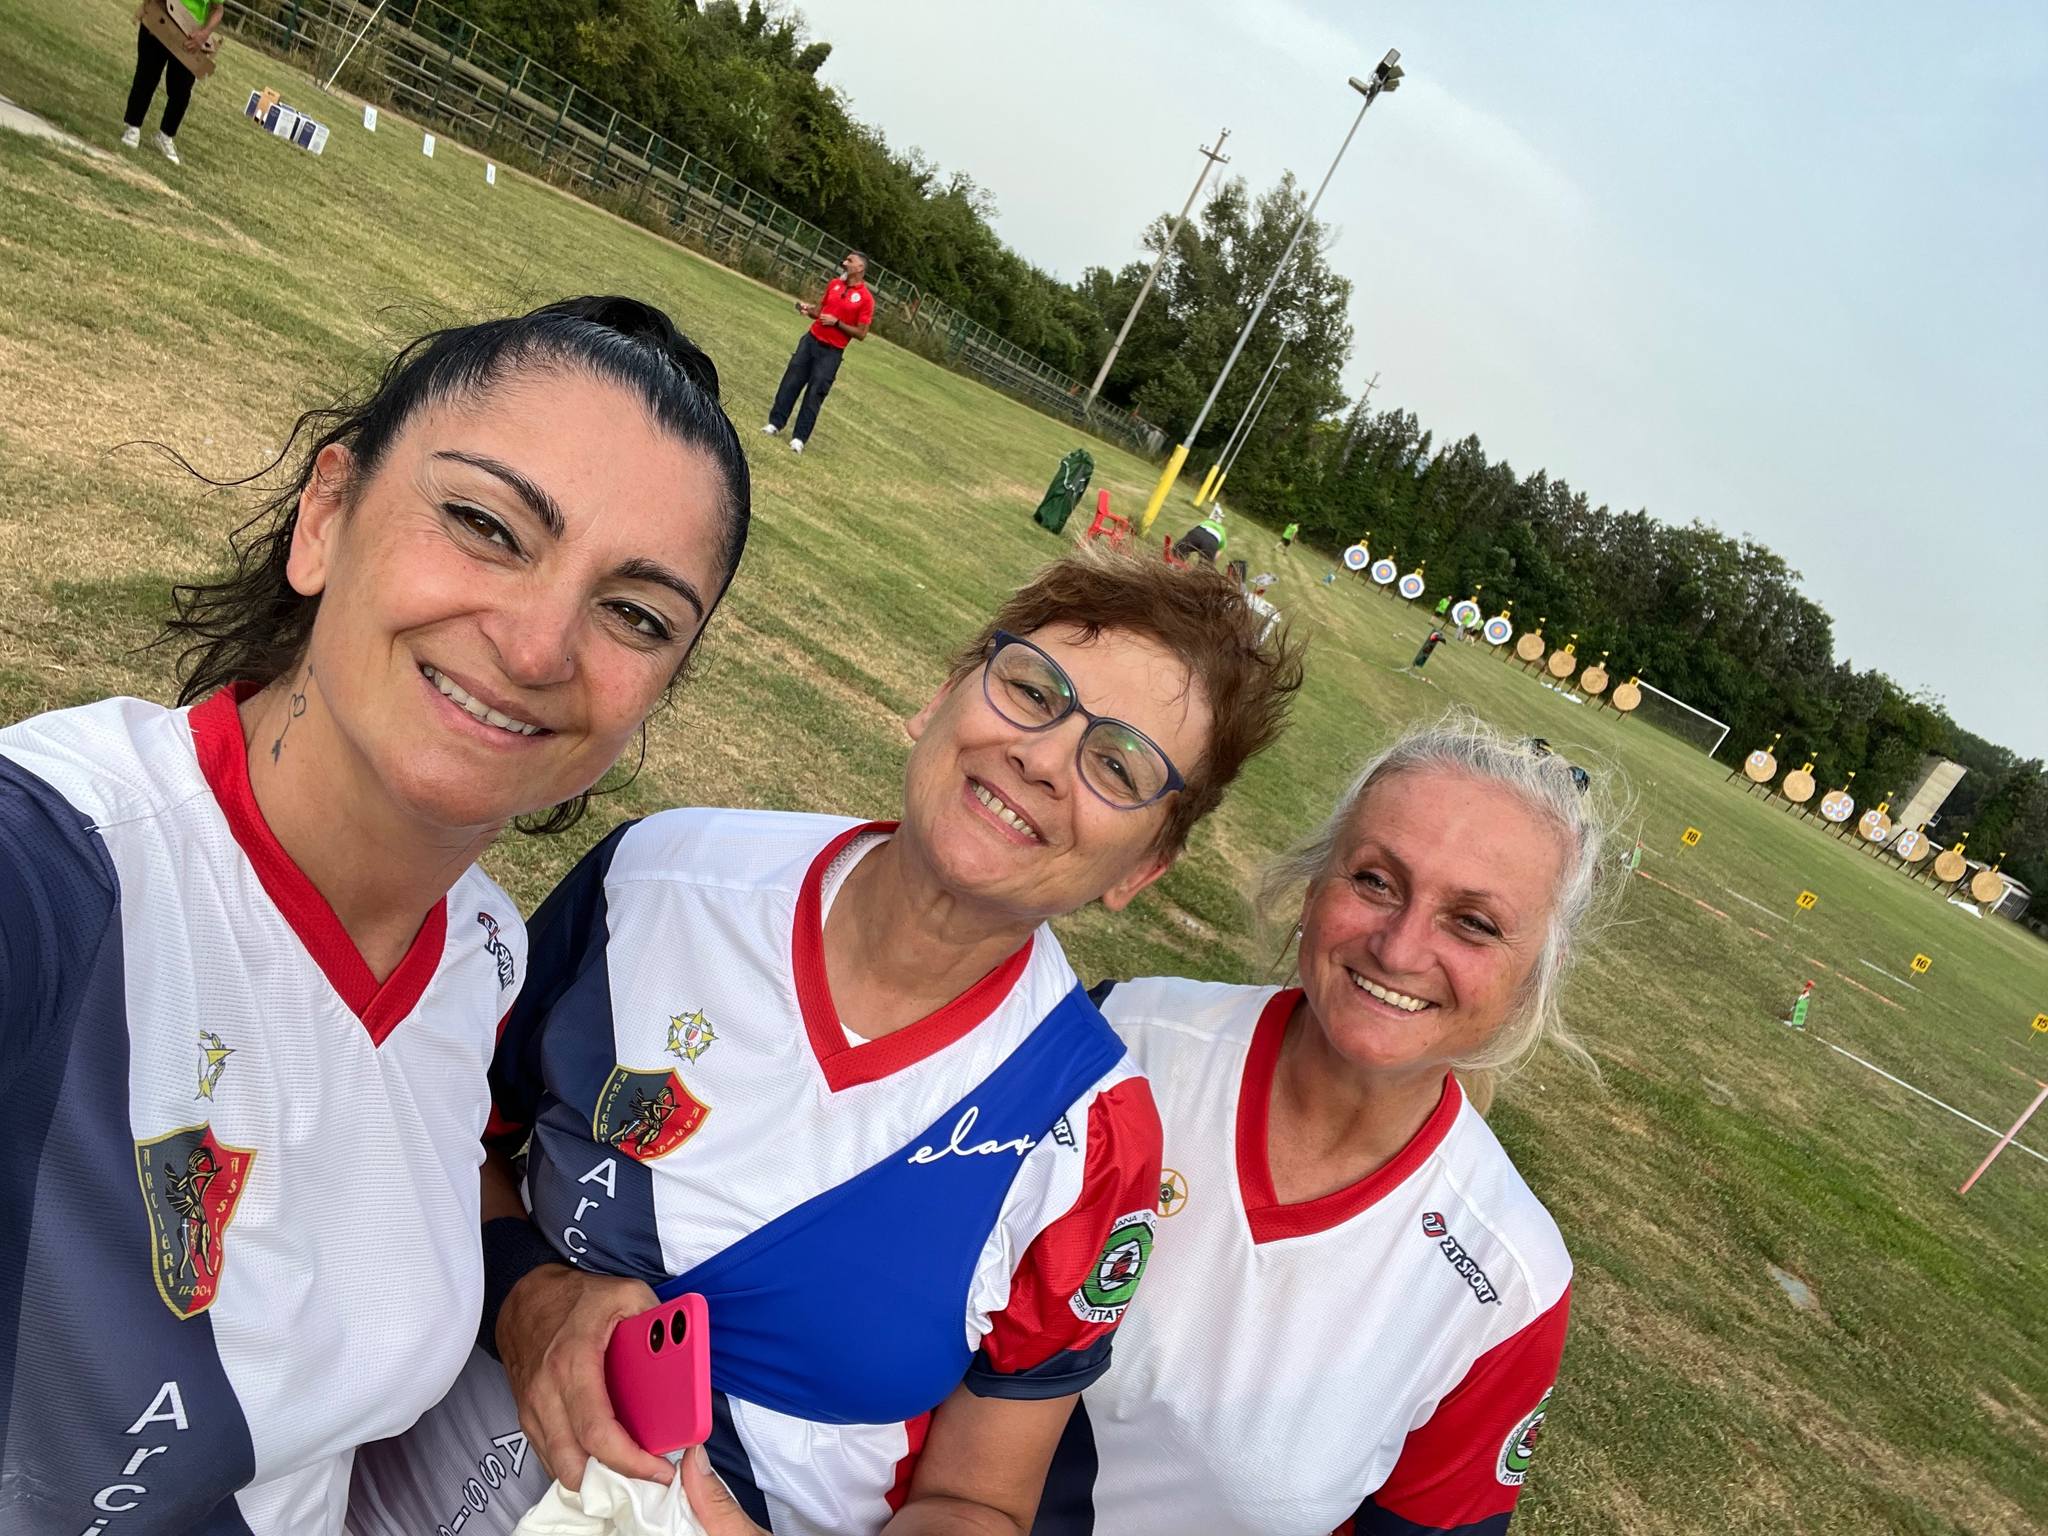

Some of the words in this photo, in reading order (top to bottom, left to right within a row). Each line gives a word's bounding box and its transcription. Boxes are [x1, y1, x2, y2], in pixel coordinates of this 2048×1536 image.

[1802, 895, 1815, 905] 17
[1915, 957, 1929, 969] 16
[564, 1157, 617, 1263] Arc
